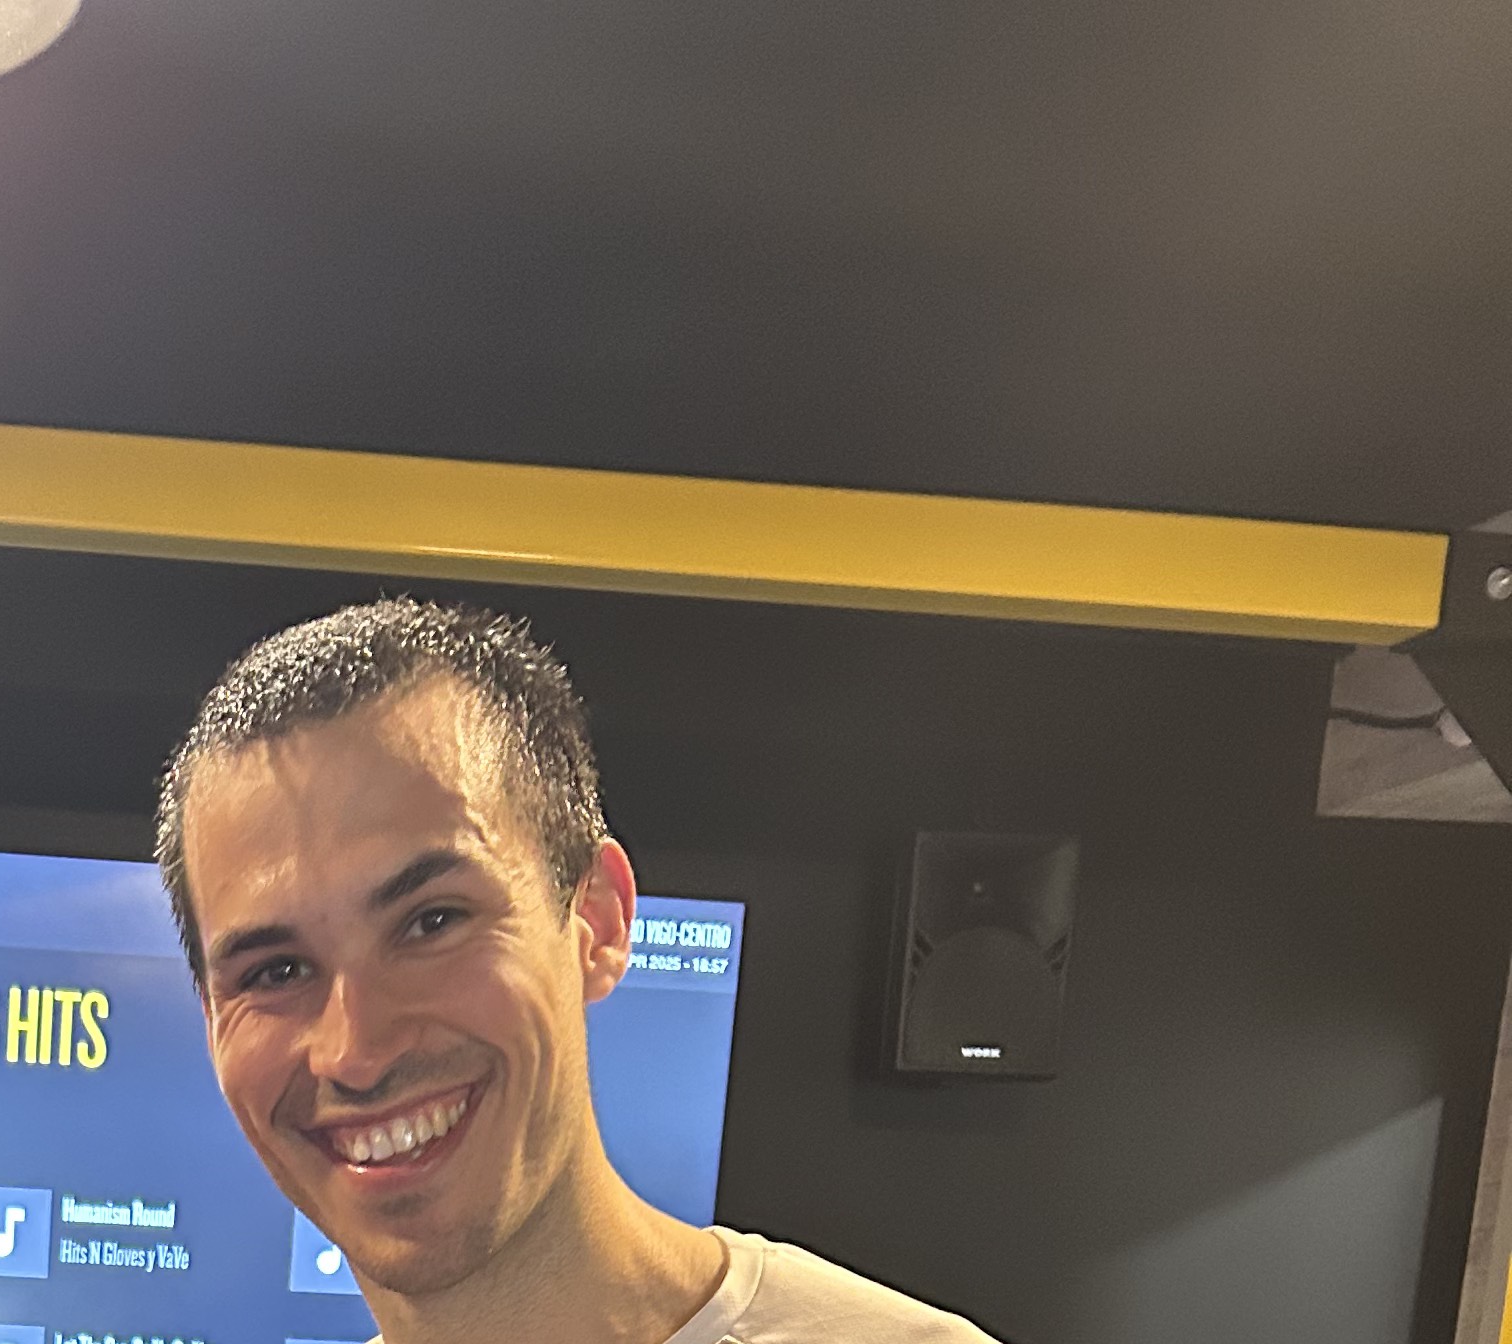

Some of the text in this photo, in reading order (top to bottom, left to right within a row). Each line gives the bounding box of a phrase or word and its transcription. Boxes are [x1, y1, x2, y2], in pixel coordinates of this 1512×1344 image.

[6, 986, 109, 1069] HITS
[62, 1196, 176, 1228] Humanism Round
[60, 1238, 190, 1273] Hits N Gloves y VaVe
